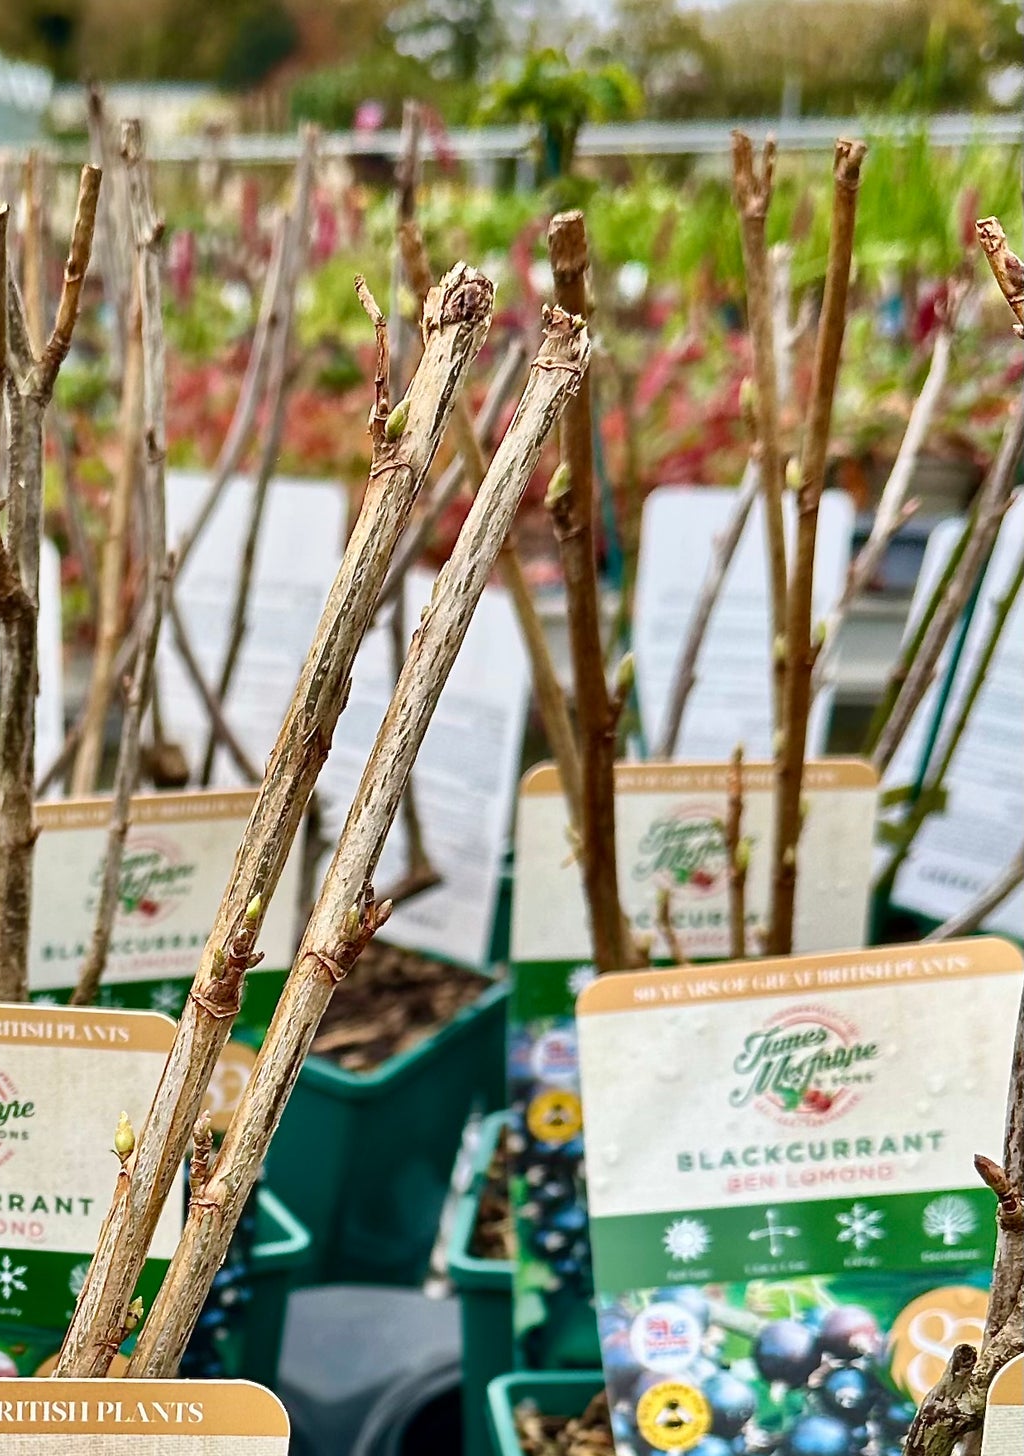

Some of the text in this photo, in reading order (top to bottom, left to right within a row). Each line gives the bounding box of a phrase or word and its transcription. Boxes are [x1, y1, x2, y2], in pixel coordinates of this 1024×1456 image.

[676, 1130, 946, 1172] BLACKCURRANT
[725, 1162, 895, 1194] BEN LOMOND
[96, 1401, 204, 1424] PLANTS
